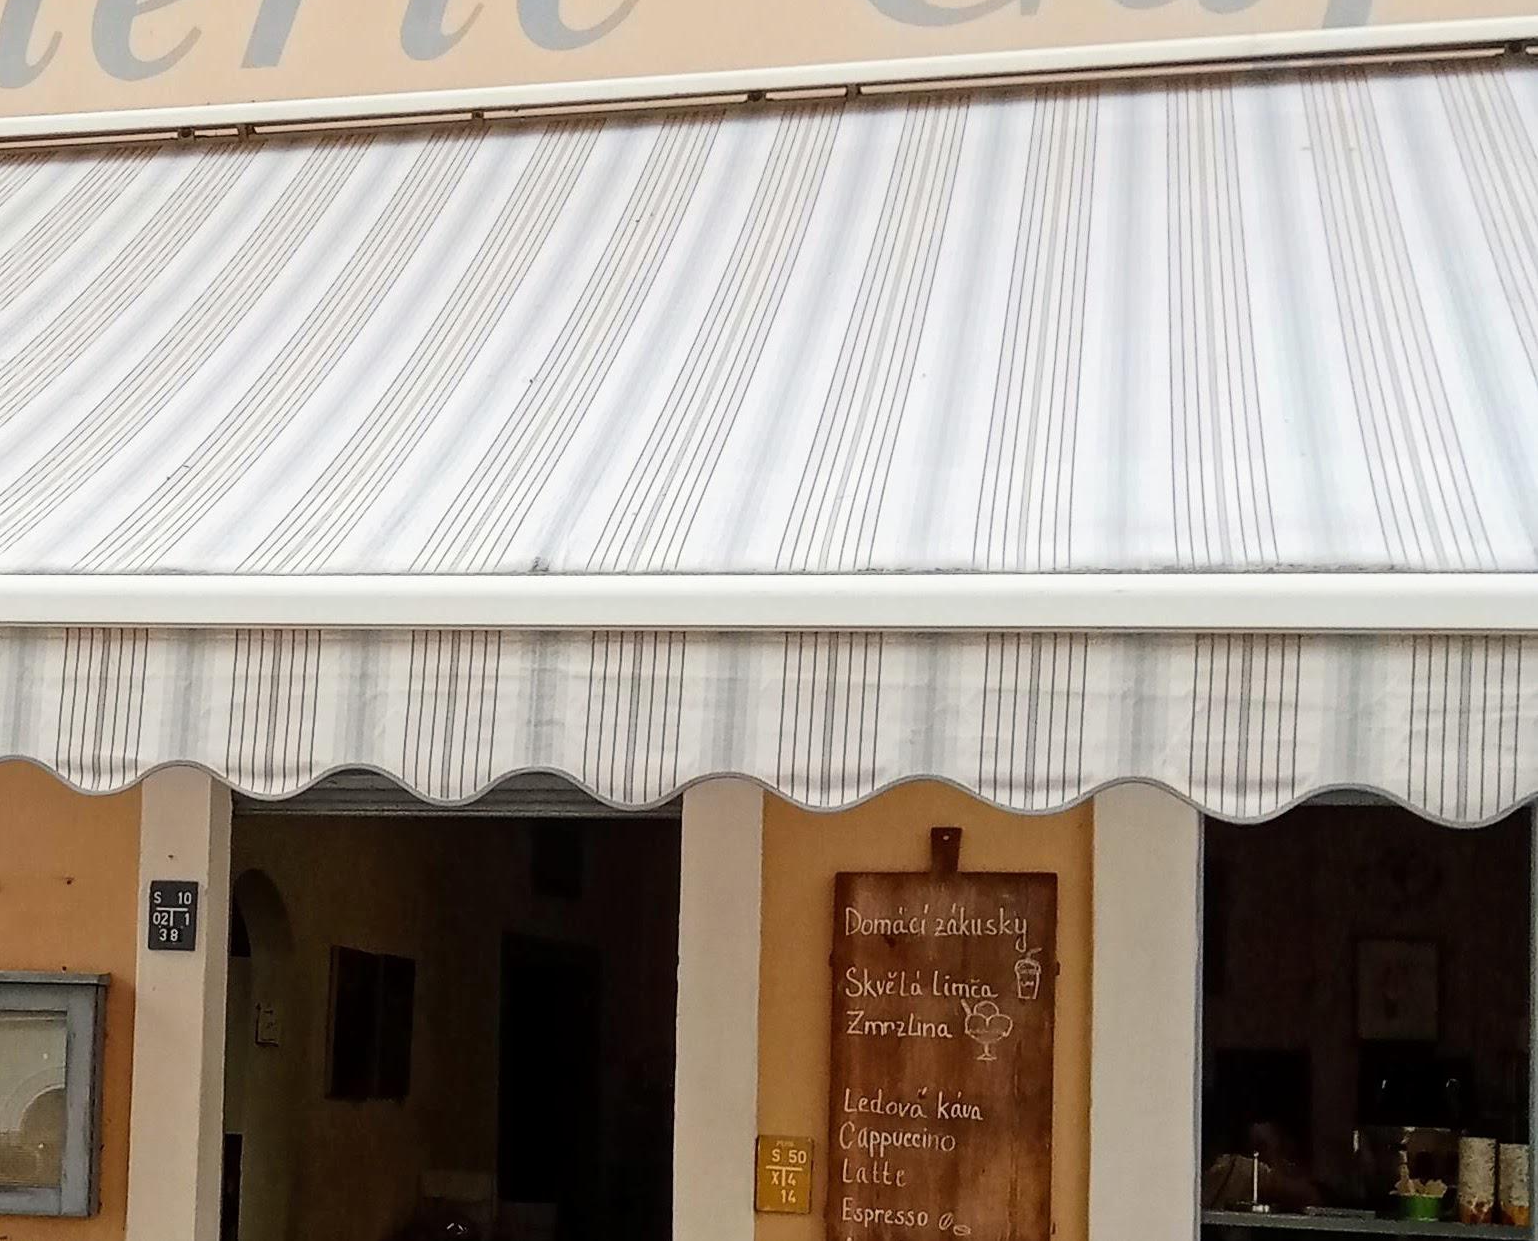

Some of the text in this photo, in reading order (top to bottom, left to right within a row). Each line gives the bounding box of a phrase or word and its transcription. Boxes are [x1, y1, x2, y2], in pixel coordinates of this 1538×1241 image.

[153, 891, 192, 905] S 10
[152, 912, 190, 926] 02 1
[845, 902, 1028, 952] Domácí zákusky
[845, 966, 924, 998] Skvělá
[846, 1010, 954, 1039] Zmrzlina
[843, 1086, 984, 1121] Ledová káva
[839, 1121, 956, 1158] Cappuccino
[771, 1148, 807, 1164] S 50
[787, 1172, 797, 1186] 4
[842, 1158, 907, 1187] Latte
[781, 1189, 797, 1204] 14
[842, 1197, 929, 1227] Espresso
